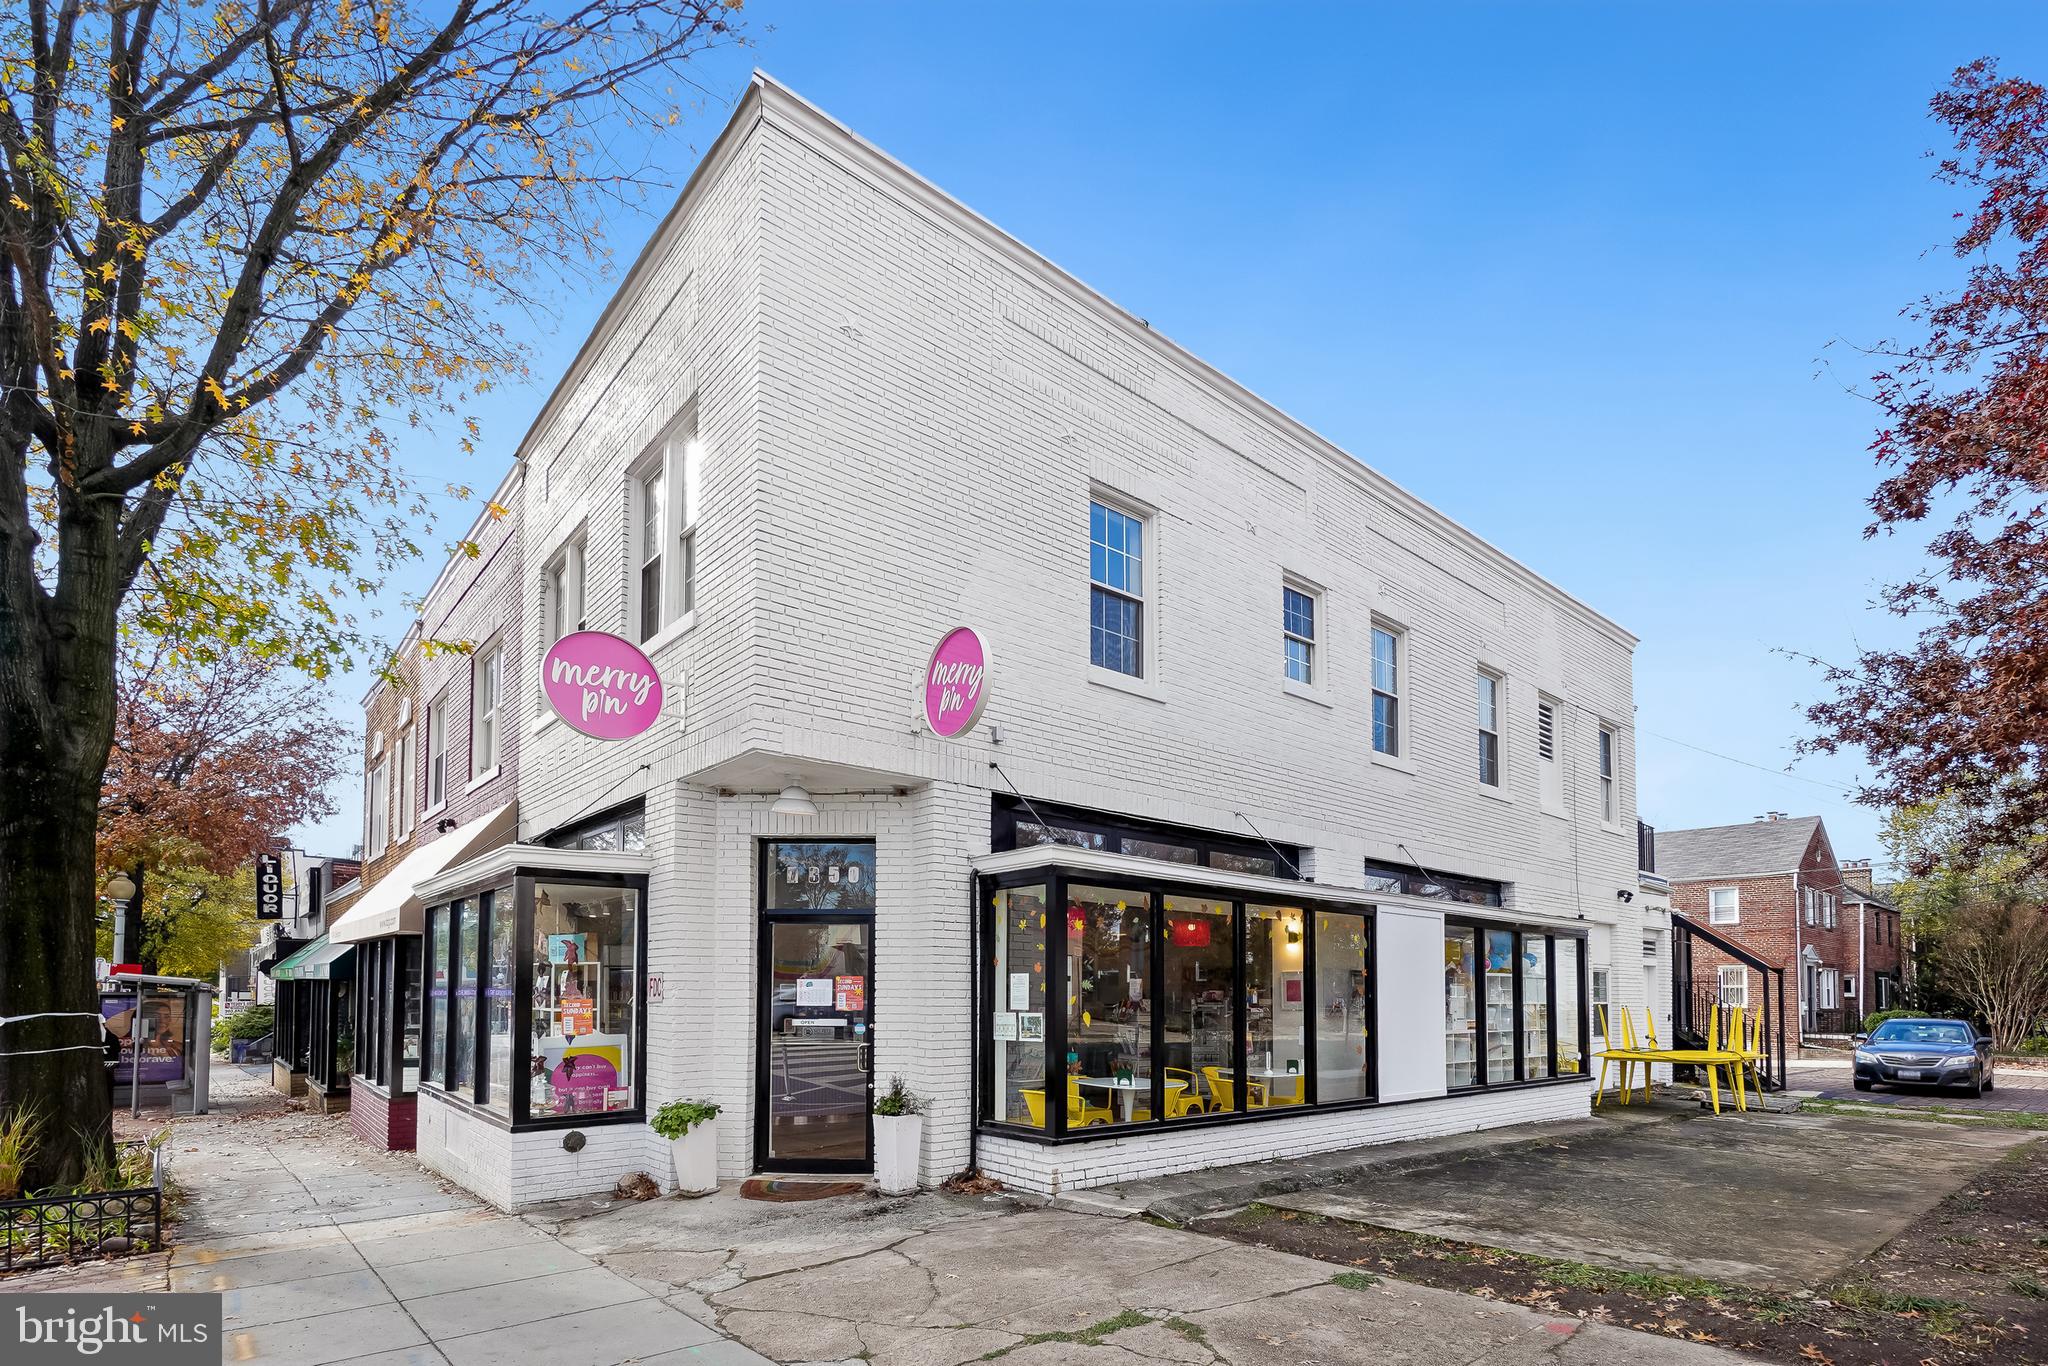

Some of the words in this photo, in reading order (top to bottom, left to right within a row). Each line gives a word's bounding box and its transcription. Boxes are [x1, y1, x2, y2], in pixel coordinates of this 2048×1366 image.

[551, 657, 656, 705] merry
[931, 660, 984, 700] merry
[582, 687, 628, 721] pin
[938, 685, 965, 720] pin
[261, 854, 279, 914] LIQUOR
[563, 1007, 592, 1015] SUNDAYS
